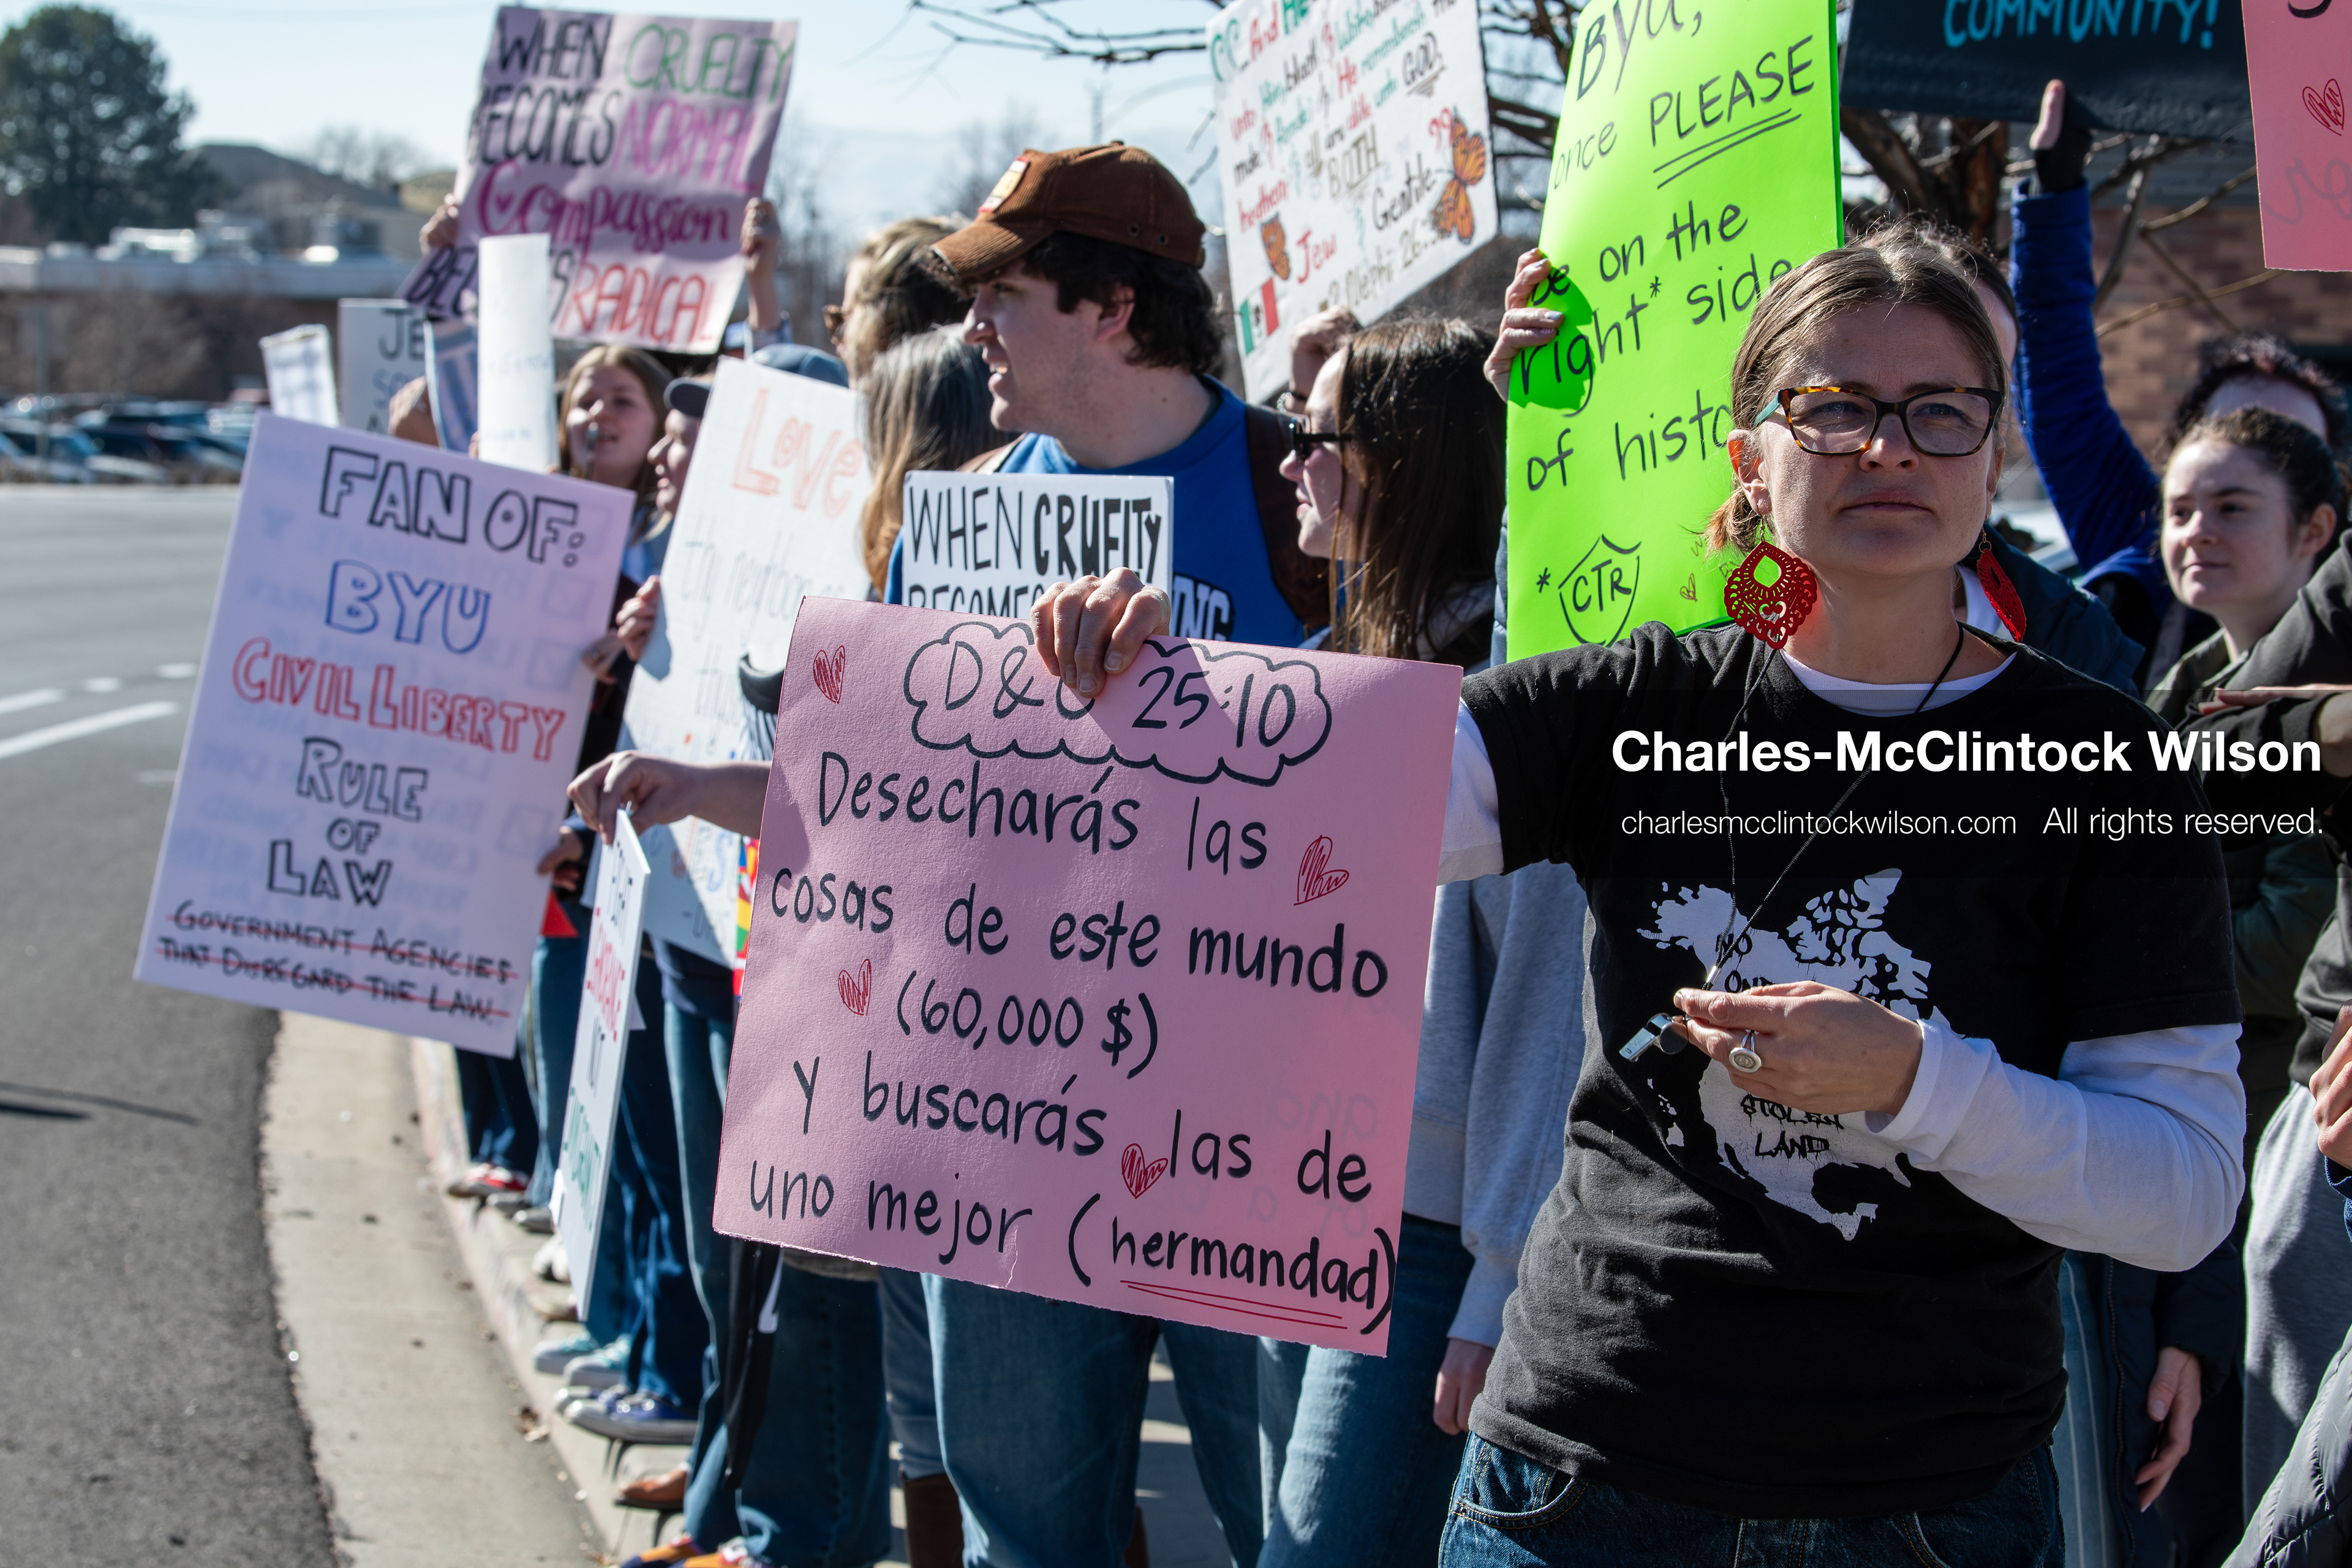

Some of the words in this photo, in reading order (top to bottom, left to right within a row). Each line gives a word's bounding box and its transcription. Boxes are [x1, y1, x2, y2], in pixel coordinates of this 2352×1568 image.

[499, 15, 612, 80] WHEN
[624, 23, 794, 105] CRUELTY
[1942, 0, 2218, 49] COMMUNITY!
[614, 98, 753, 192] NORMAL
[1554, 122, 1617, 190] once
[1650, 35, 1814, 147] PLEASE
[1327, 123, 1381, 199] BOTH
[477, 157, 730, 257] Compassion
[1600, 235, 1644, 282] on
[1666, 200, 1748, 262] the
[1297, 229, 1338, 284] Jew
[559, 258, 717, 345] RADICAL
[732, 387, 863, 518] Love
[1528, 428, 1574, 490] of
[1615, 390, 1733, 480] histo
[319, 445, 471, 544] FAN
[484, 489, 586, 568] OF:
[910, 486, 1023, 571] WHEN
[1033, 492, 1162, 584] CRUELTY
[325, 559, 491, 654] BYU
[1572, 559, 1632, 611] CTR
[232, 636, 360, 722] CIVIL
[368, 664, 567, 762] LIBERTY
[1131, 665, 1297, 748] 25:10
[297, 737, 428, 822] RULE
[818, 751, 1141, 855] Desecharás
[1187, 796, 1267, 876] las
[268, 839, 393, 908] LAW
[327, 818, 381, 854] OF
[158, 936, 210, 965] THAT
[221, 946, 355, 994] DISREGARD
[364, 976, 417, 1003] THE
[173, 900, 355, 956] GOVERNMENT
[369, 927, 512, 983] AGENCIES
[771, 867, 894, 934] cosas
[944, 883, 1009, 955] de
[1050, 900, 1160, 971] este
[1189, 922, 1389, 998] mundo
[1715, 932, 1753, 959] NO
[897, 970, 1085, 1050] (60,000
[864, 1050, 1107, 1156] buscarás
[1169, 1109, 1252, 1181] las
[1297, 1129, 1372, 1203] de
[1740, 1093, 1845, 1130] STOLEN
[1754, 1130, 1830, 1160] LAND
[750, 1160, 835, 1221] uno
[867, 1172, 1033, 1265] mejor
[1068, 1193, 1397, 1335] (hermandad)
